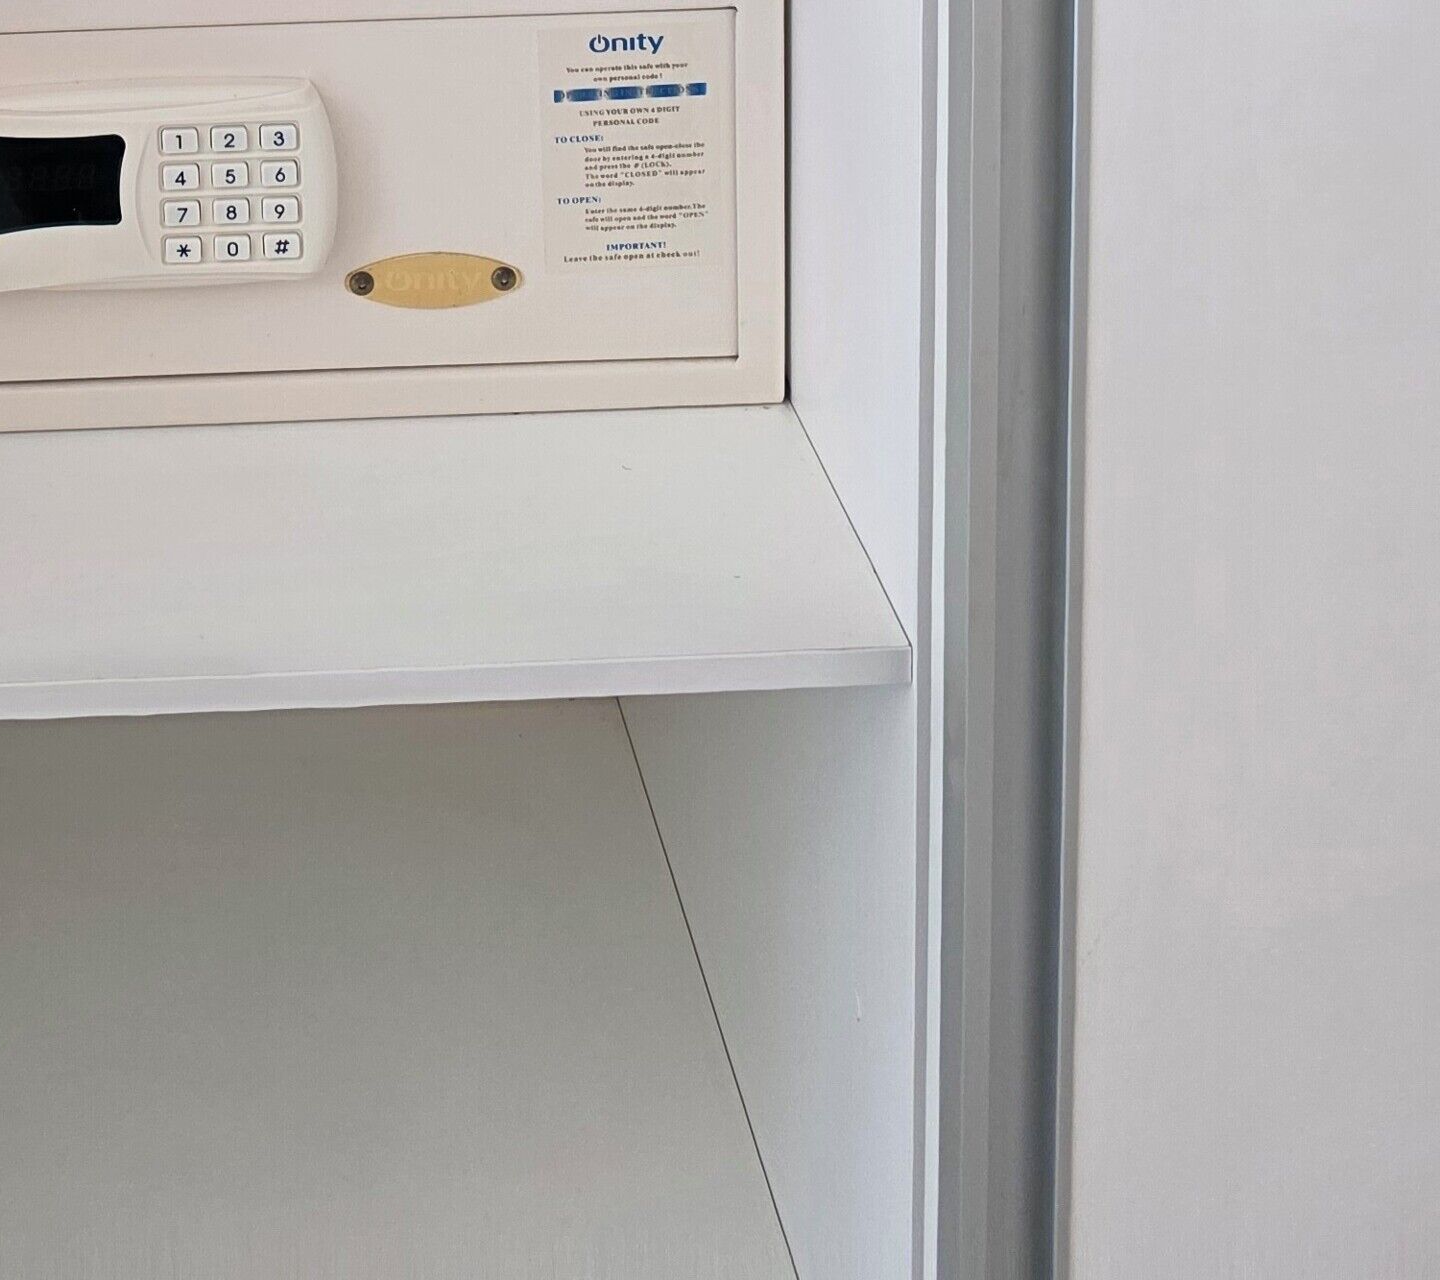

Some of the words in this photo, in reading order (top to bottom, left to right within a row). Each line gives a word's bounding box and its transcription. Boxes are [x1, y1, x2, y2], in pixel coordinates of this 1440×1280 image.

[589, 33, 664, 54] Onity
[595, 65, 622, 73] operate
[609, 74, 640, 83] personal
[175, 135, 182, 150] 1
[224, 133, 235, 148] 2
[273, 131, 285, 147] 3
[569, 135, 604, 143] CLOSE:
[175, 171, 186, 186] 4
[225, 169, 236, 184] 5
[275, 167, 286, 182] 6
[177, 207, 188, 223] 7
[226, 205, 237, 220] 8
[274, 204, 285, 219] 9
[227, 242, 239, 257] 0
[606, 241, 667, 251] IMPORTANT!
[623, 253, 644, 261] open
